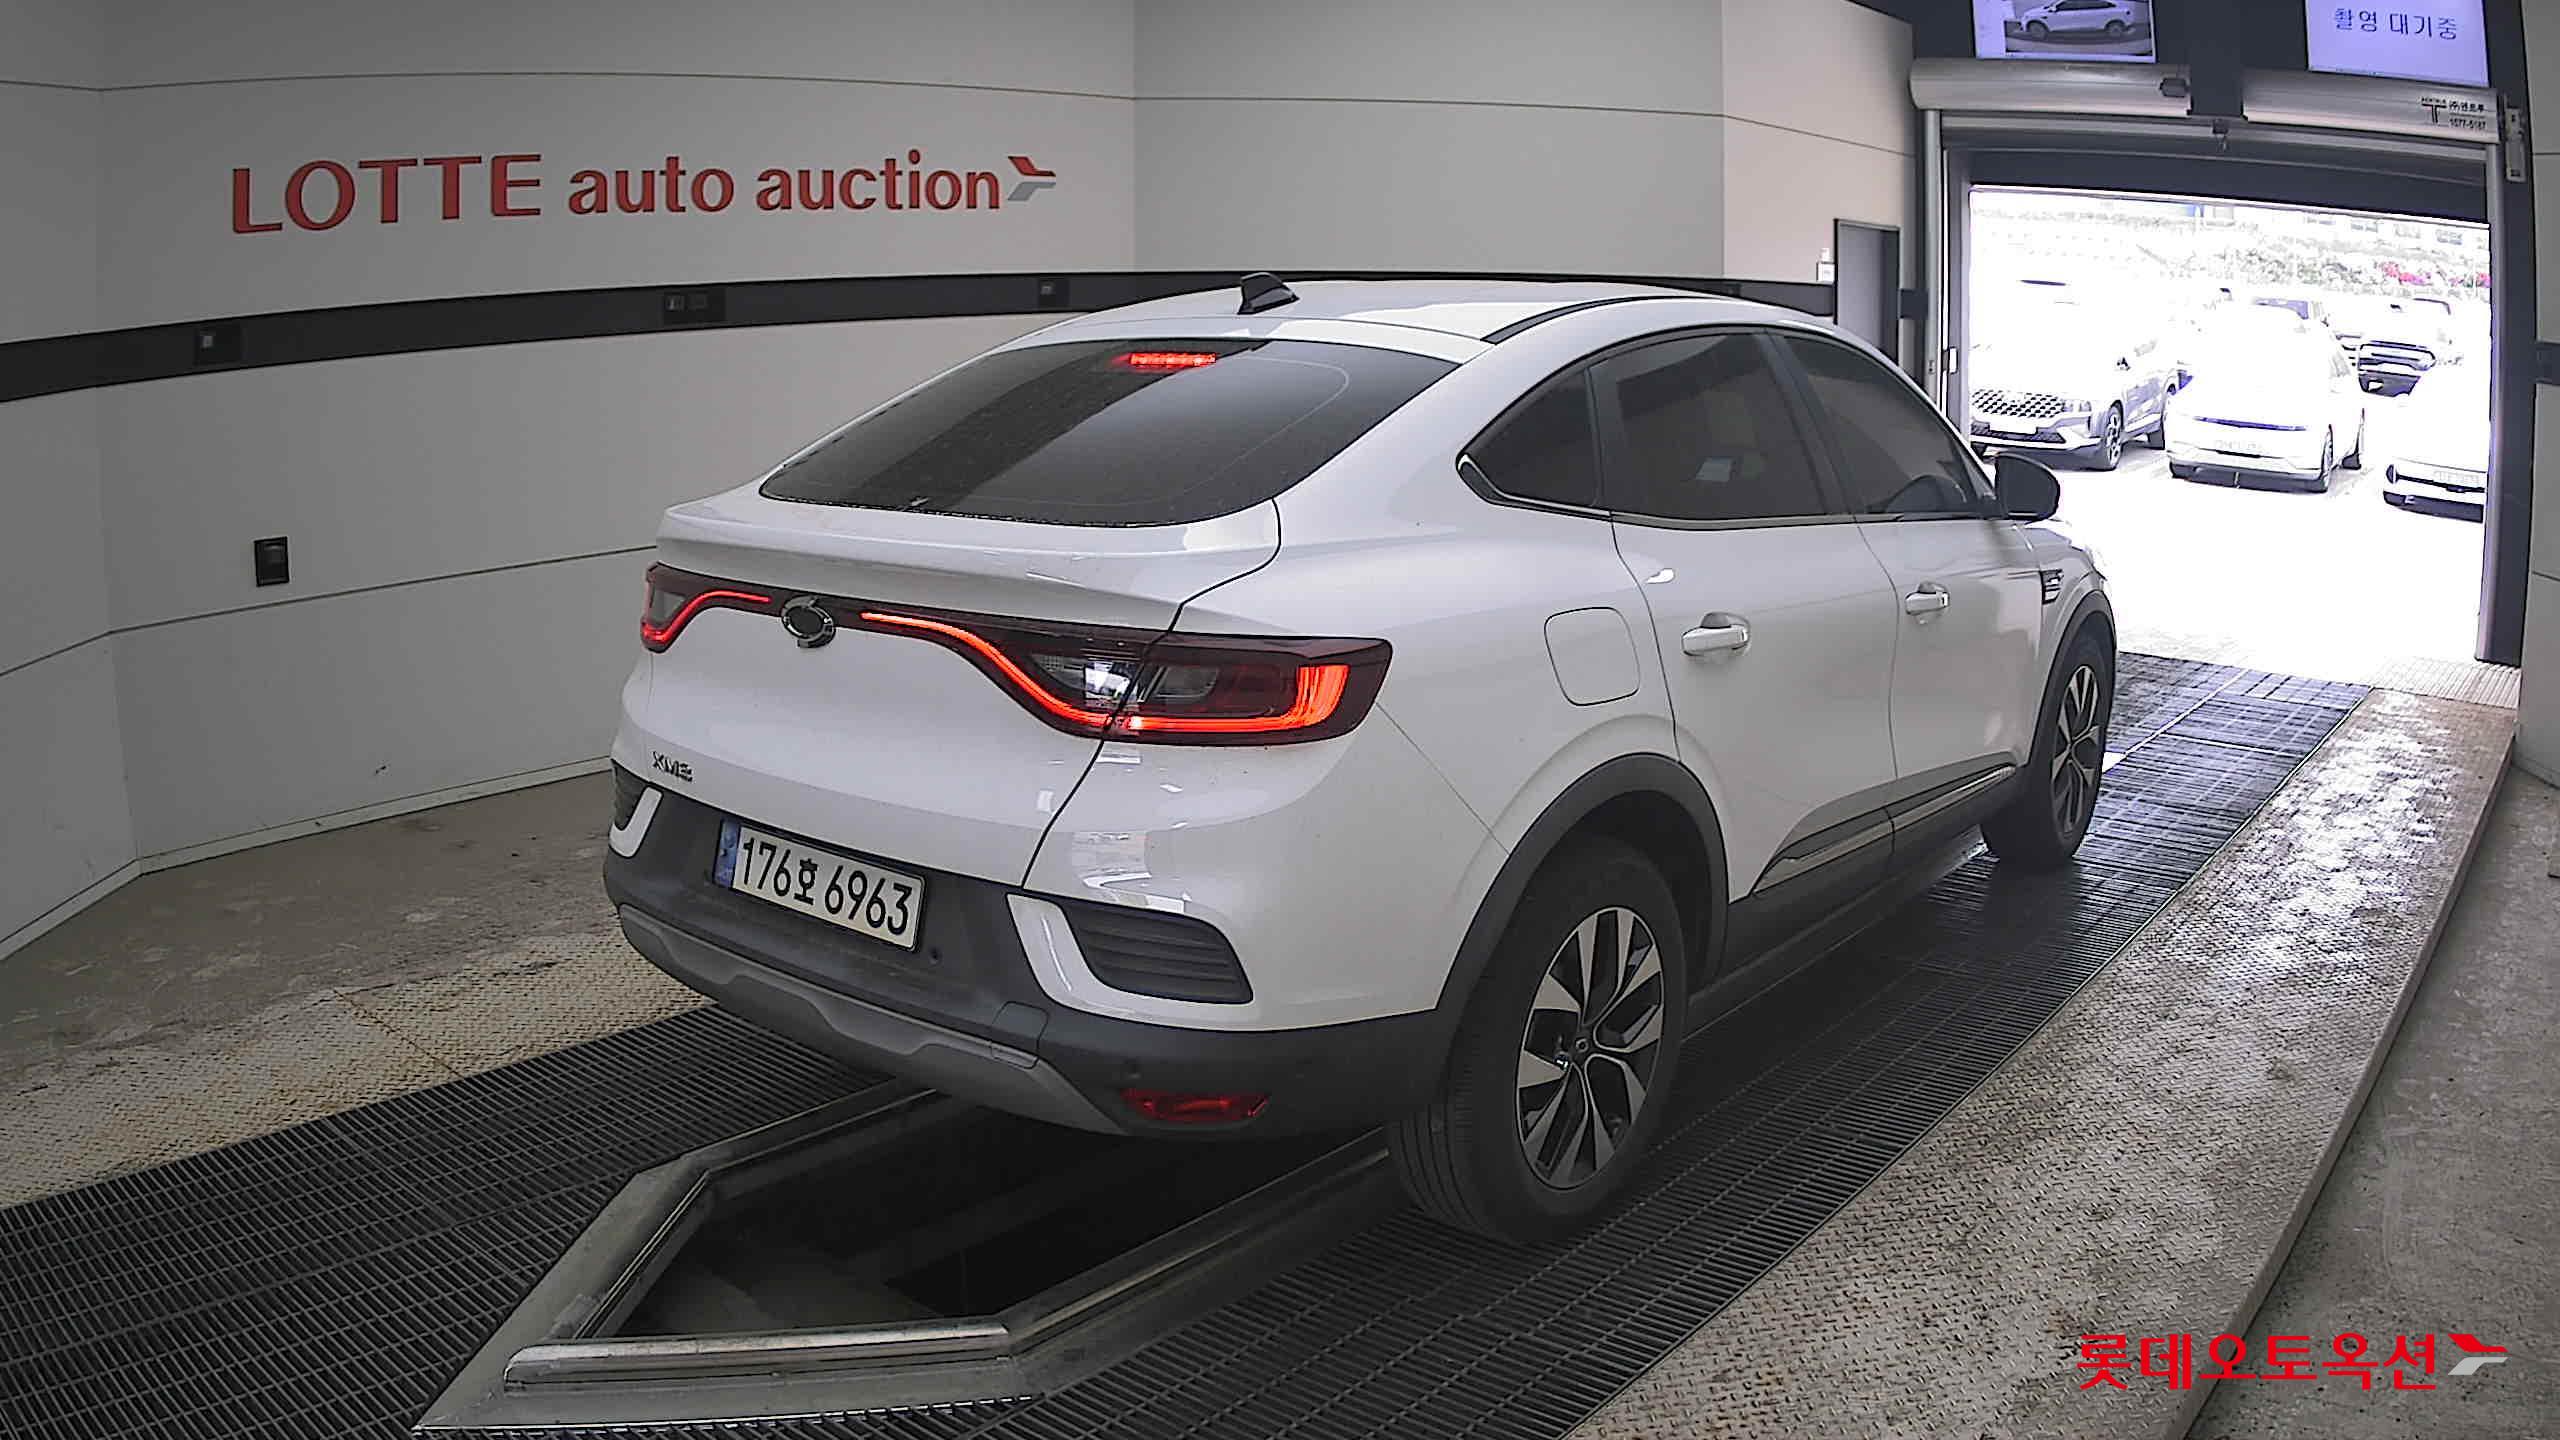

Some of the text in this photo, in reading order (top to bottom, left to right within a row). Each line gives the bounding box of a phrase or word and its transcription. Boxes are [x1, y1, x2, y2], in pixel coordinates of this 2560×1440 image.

[2334, 8, 2457, 41] 촬영 대기중
[233, 149, 1000, 234] LOTTE auto auction
